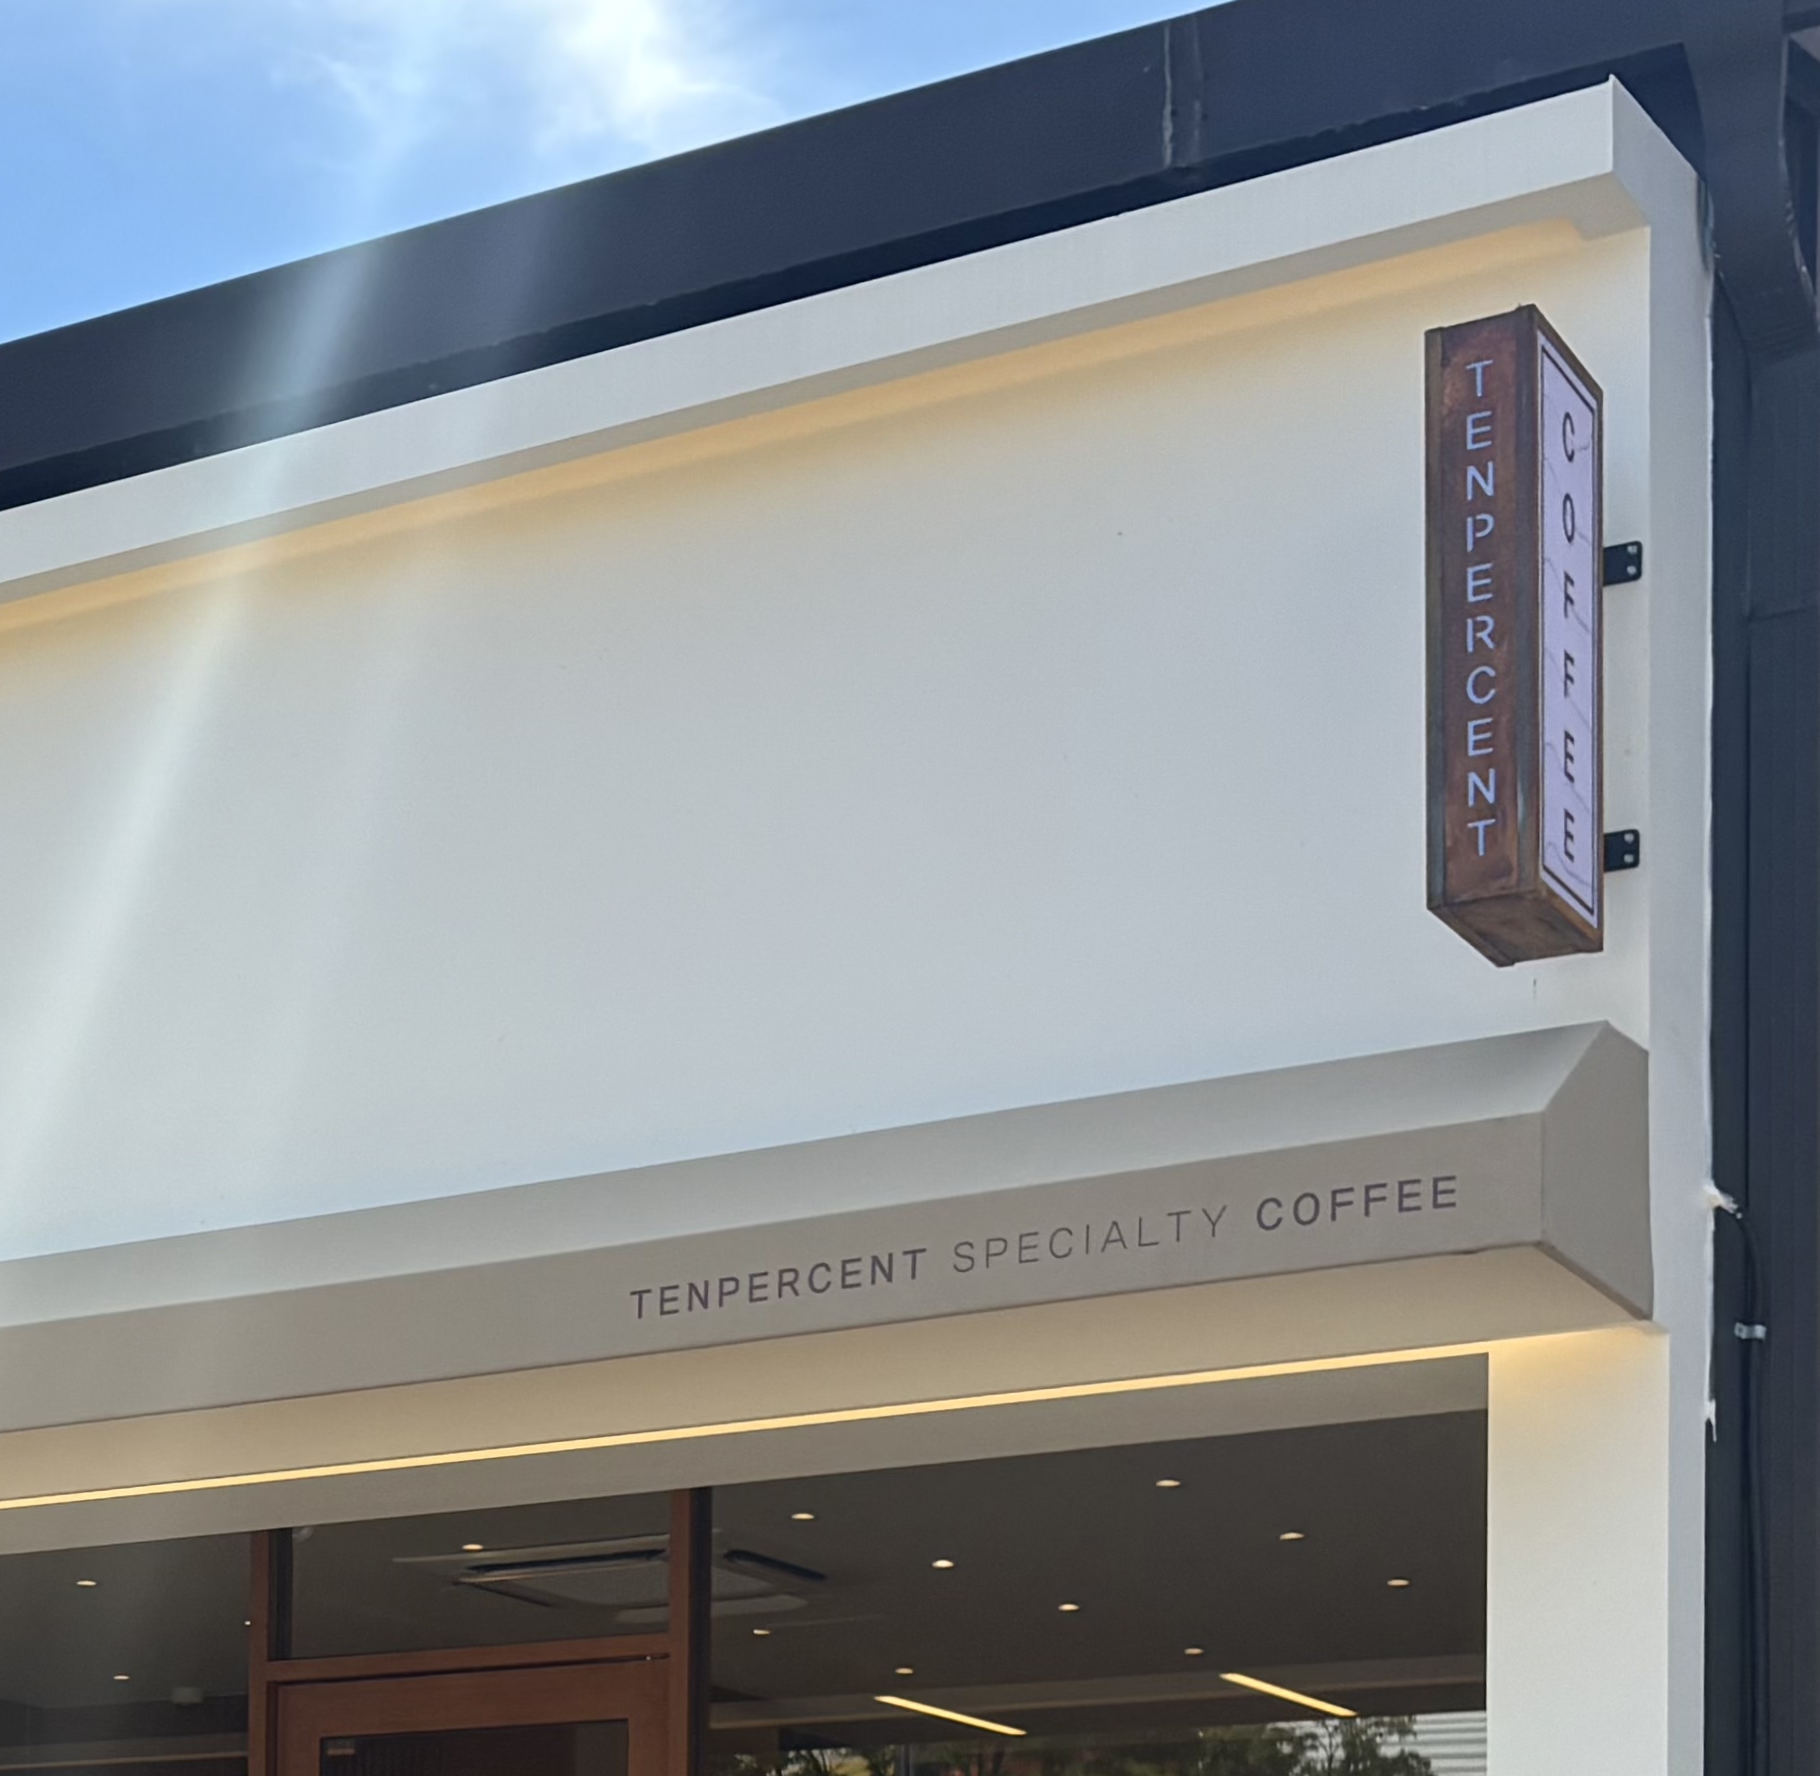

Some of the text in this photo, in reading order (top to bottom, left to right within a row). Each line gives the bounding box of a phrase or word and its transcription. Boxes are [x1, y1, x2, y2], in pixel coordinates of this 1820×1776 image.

[1464, 359, 1496, 857] TENPERCENT
[1561, 411, 1577, 864] COFFEE
[630, 1174, 1459, 1321] TENPERCENT SPECIALTY COFFEE
